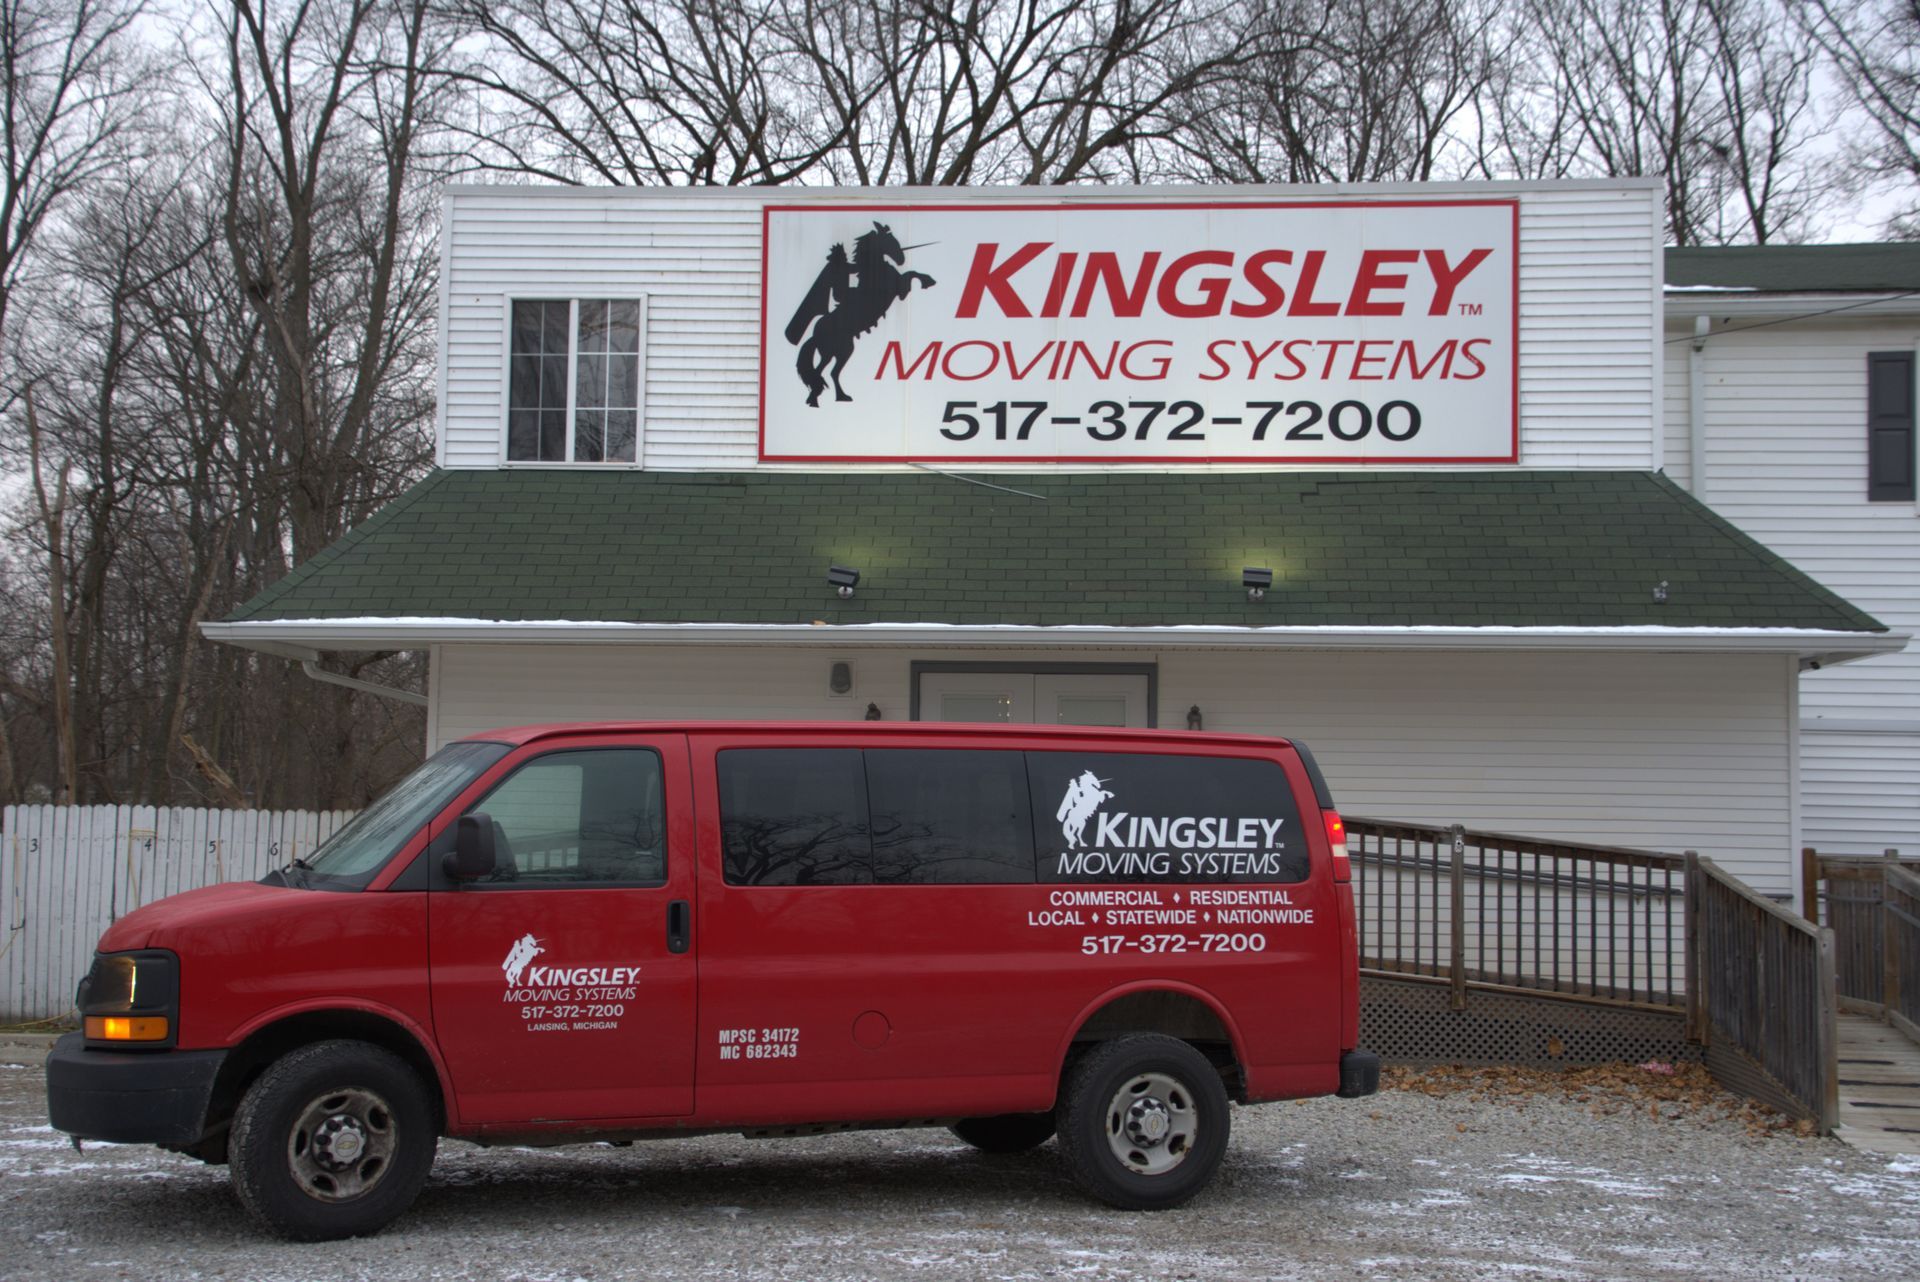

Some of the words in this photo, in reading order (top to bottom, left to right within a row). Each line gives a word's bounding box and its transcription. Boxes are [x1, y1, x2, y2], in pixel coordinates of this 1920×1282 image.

[954, 241, 1495, 318] KINGSLEY
[1458, 303, 1484, 316] TM
[874, 338, 1173, 381] MOVING
[1198, 337, 1492, 381] SYSTEMS
[938, 399, 1422, 442] 517-372-7200
[1095, 812, 1285, 848] KINGSLEY
[29, 838, 39, 853] 3
[143, 838, 153, 851] 4
[208, 840, 217, 853] 5
[270, 842, 279, 856] 6
[1057, 853, 1170, 875] MOVING
[1179, 852, 1281, 875] SYSTEMS
[1050, 891, 1163, 906] COMMERCIAL
[1190, 890, 1293, 905] RESIDENTIAL
[1028, 911, 1085, 926] LOCAL
[1106, 910, 1197, 925] STATEWIDE
[1217, 909, 1314, 924] NATIONWIDE
[1081, 933, 1266, 955] 517-372-7200
[527, 966, 641, 986] KINGSLEY
[503, 988, 570, 1002] MOVING
[575, 987, 637, 1001] SYSTEMS
[521, 1004, 624, 1019] 517-372-7200
[527, 1023, 570, 1031] LANSING,
[573, 1021, 618, 1031] MICHIGAN
[719, 1029, 756, 1044] MPSC
[762, 1028, 799, 1042] 34172
[720, 1045, 740, 1059] MC
[746, 1044, 797, 1058] 682343
